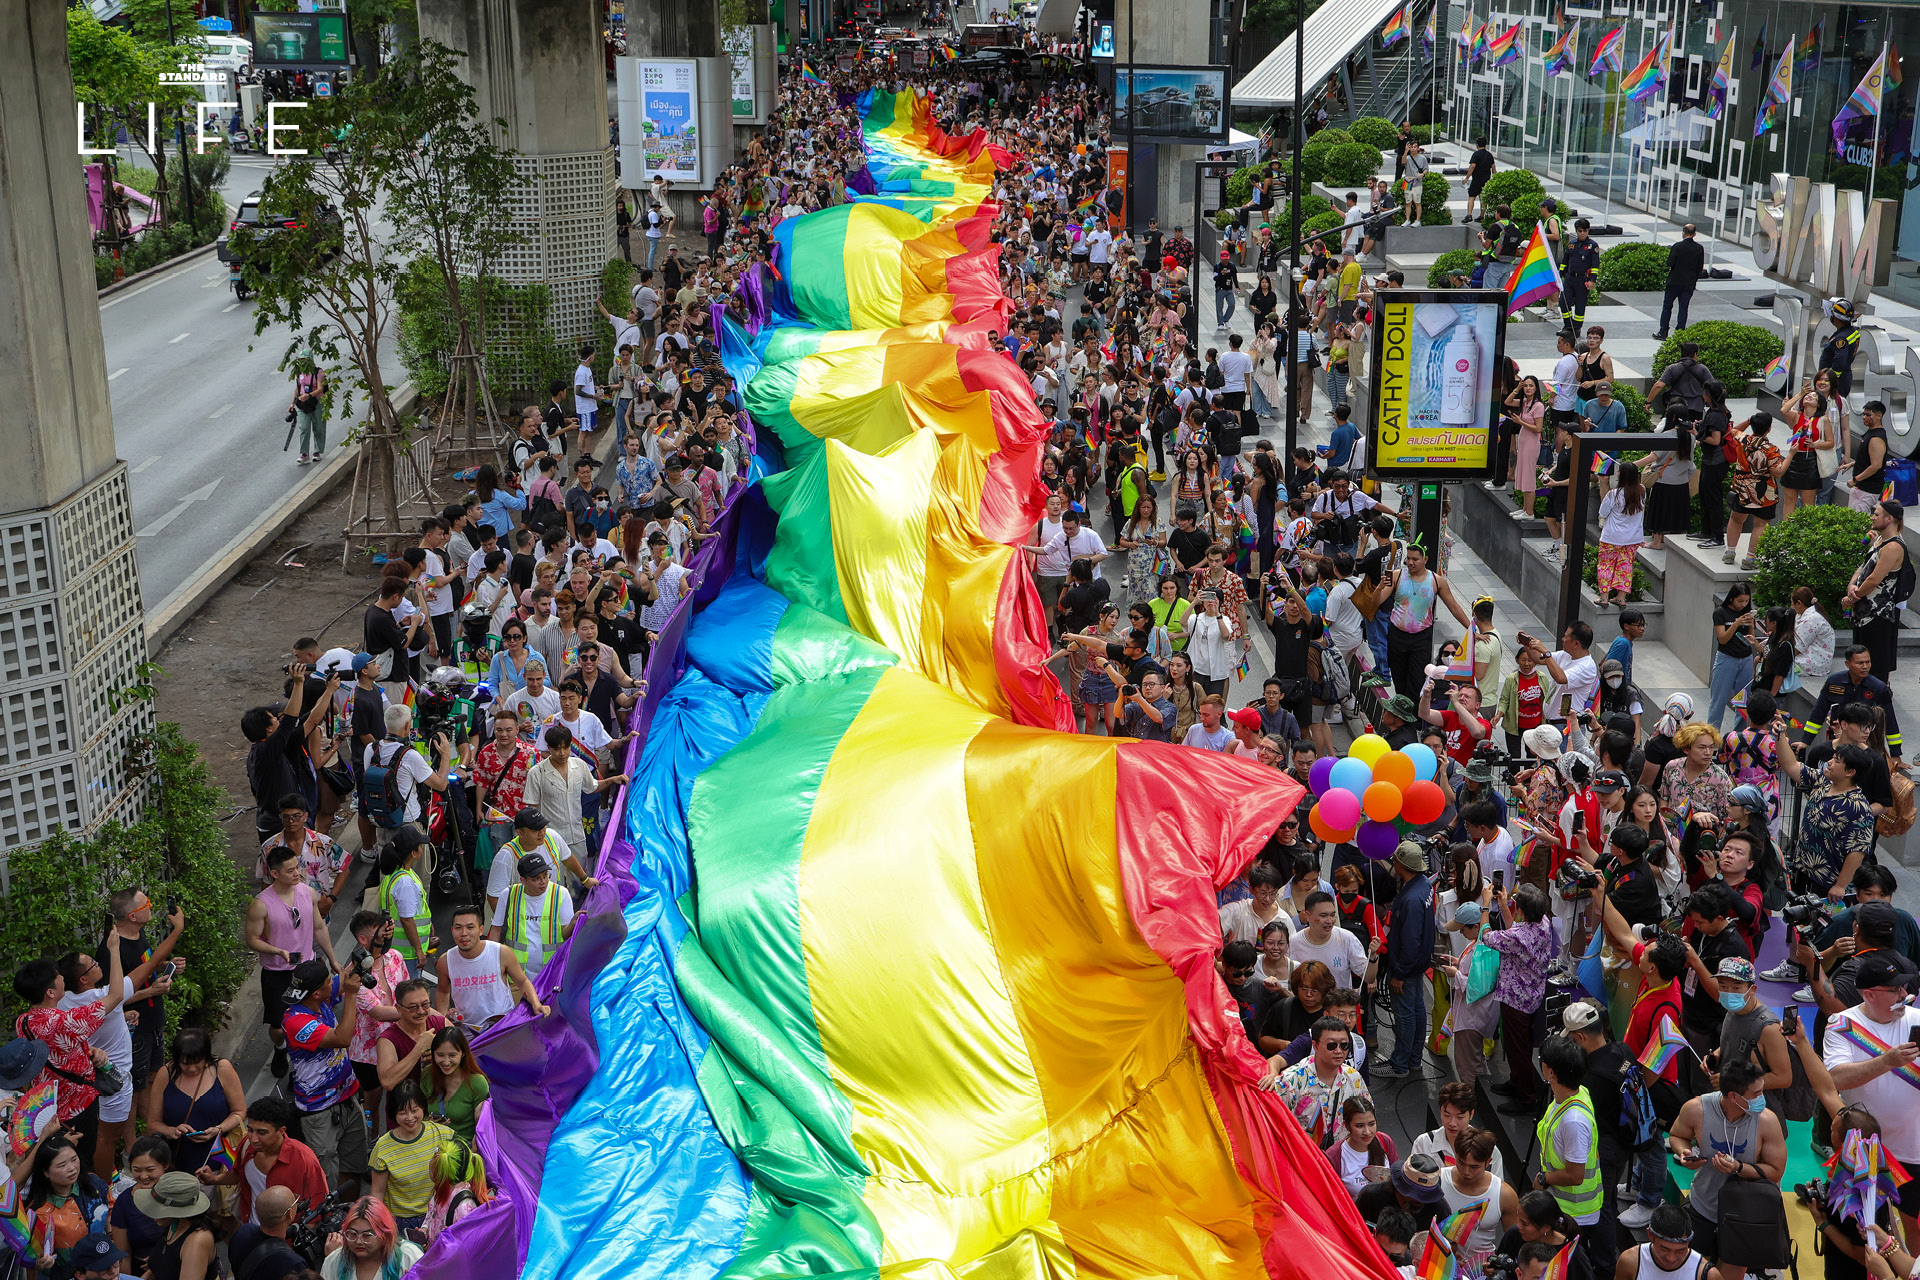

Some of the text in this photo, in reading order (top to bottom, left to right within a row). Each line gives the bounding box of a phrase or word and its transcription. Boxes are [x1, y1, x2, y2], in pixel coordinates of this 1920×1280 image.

[668, 109, 683, 119] คุณ
[1846, 144, 1874, 168] CLUB2
[1752, 172, 1898, 304] SIAM
[1386, 307, 1407, 361] DOLL
[1382, 369, 1403, 446] CATHY
[1619, 1060, 1631, 1074] PRESS
